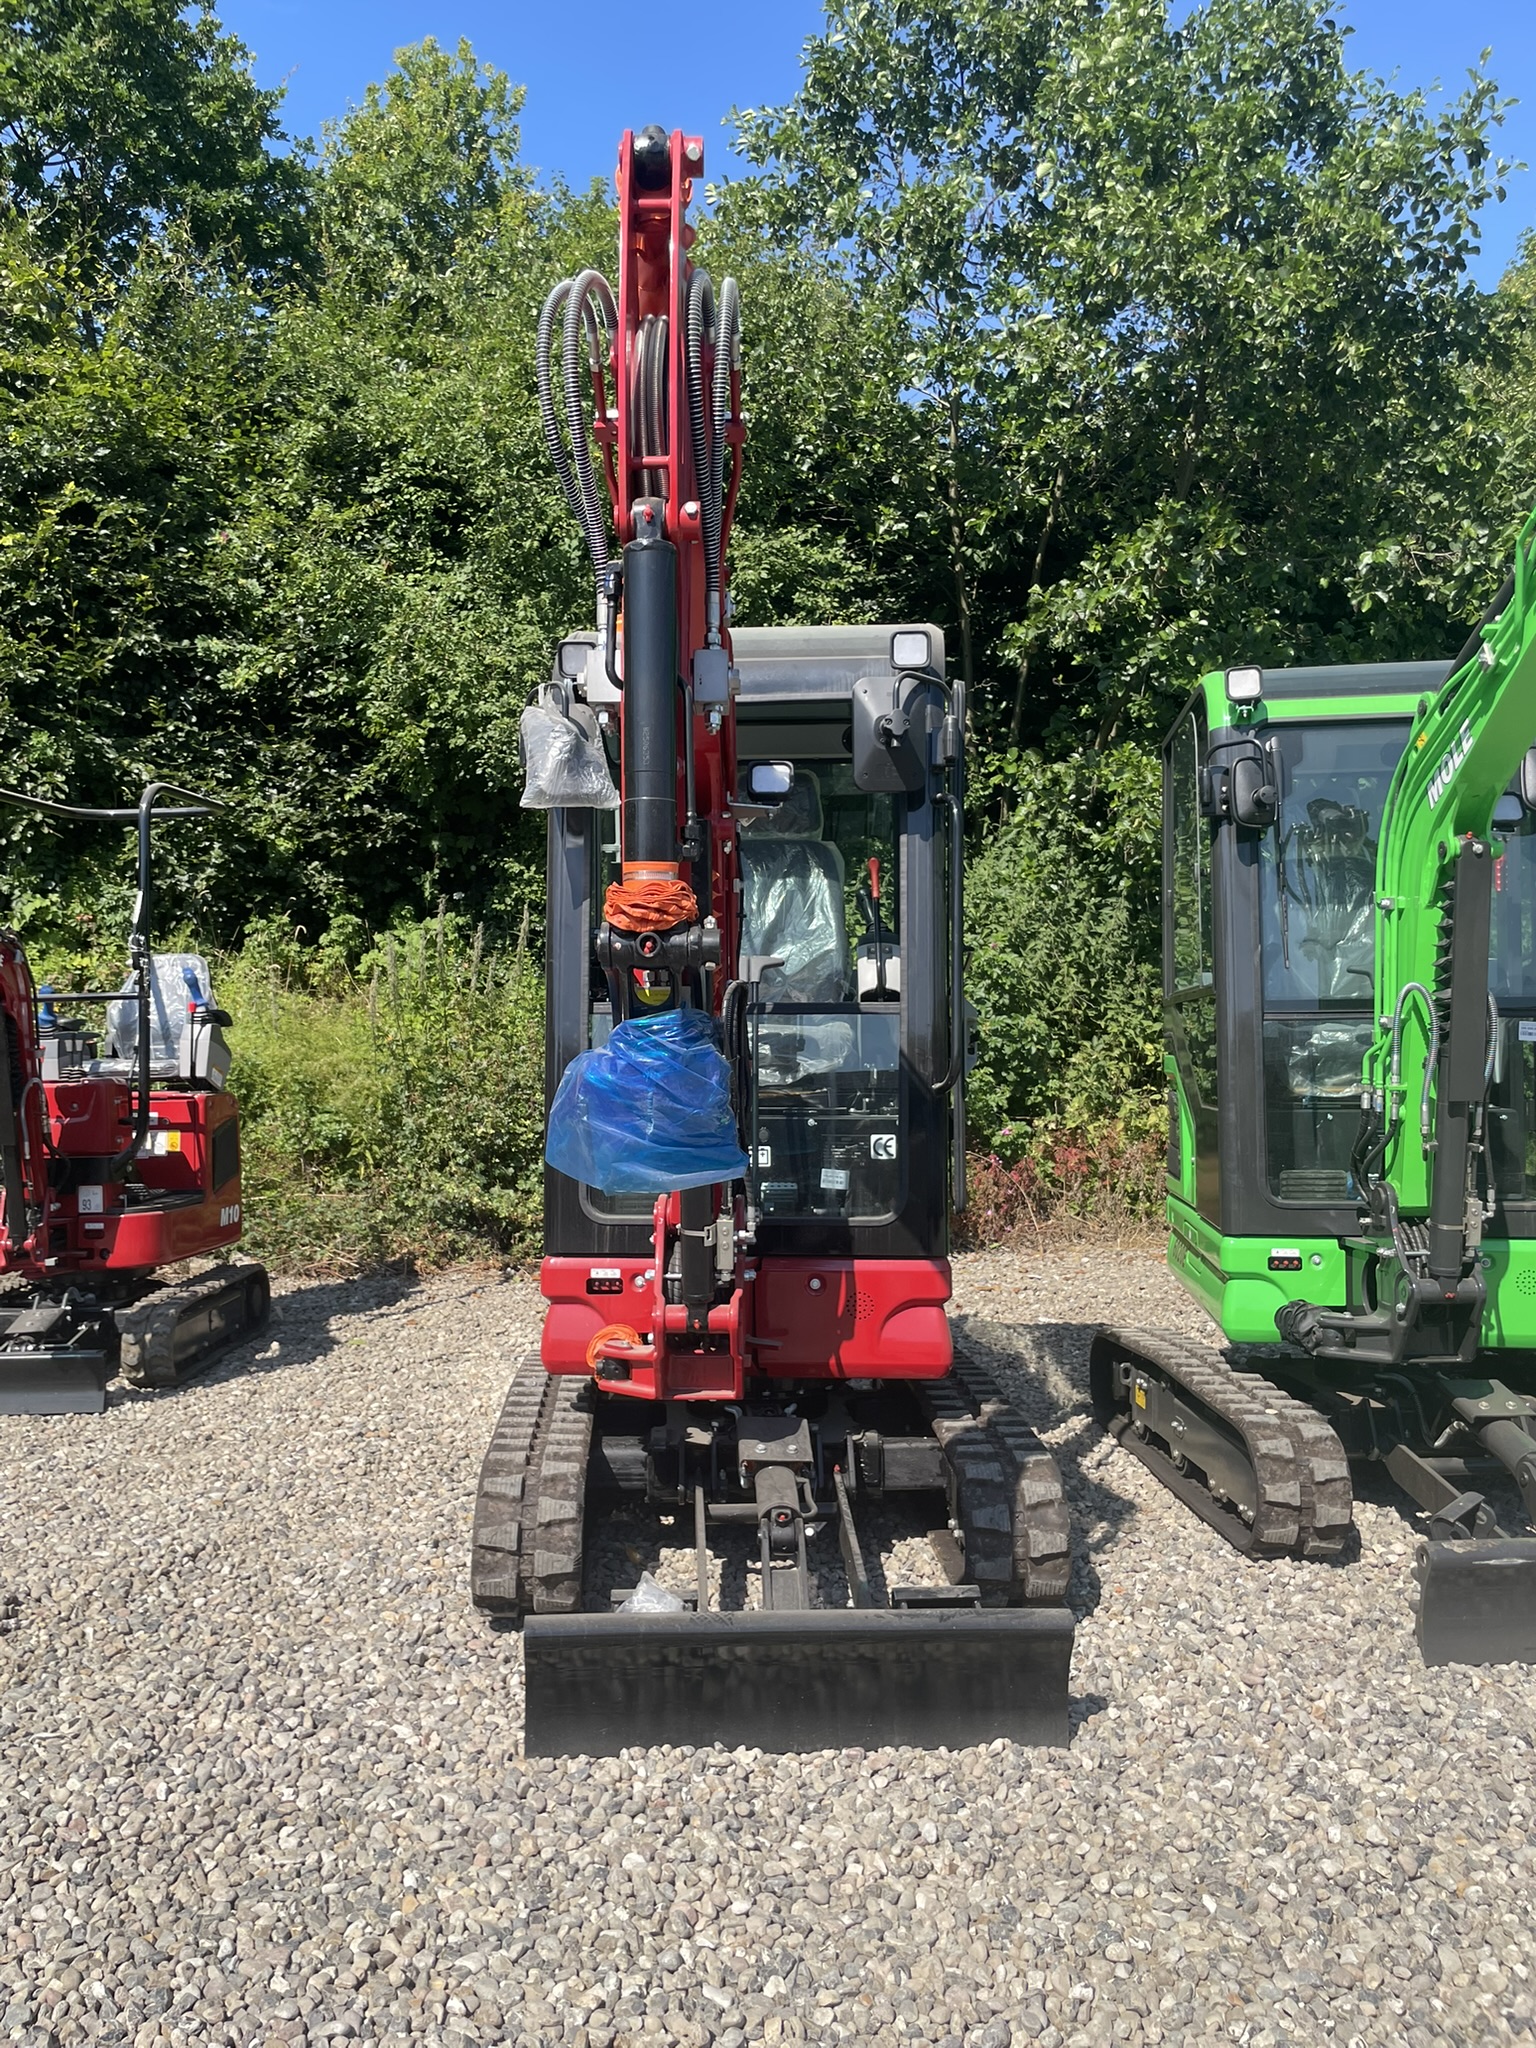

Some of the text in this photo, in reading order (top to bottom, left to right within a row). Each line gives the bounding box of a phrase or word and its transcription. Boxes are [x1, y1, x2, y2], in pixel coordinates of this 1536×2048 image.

[1426, 717, 1474, 811] MOLE
[873, 1137, 895, 1157] CE
[82, 1198, 92, 1210] 93
[220, 1204, 240, 1227] M10
